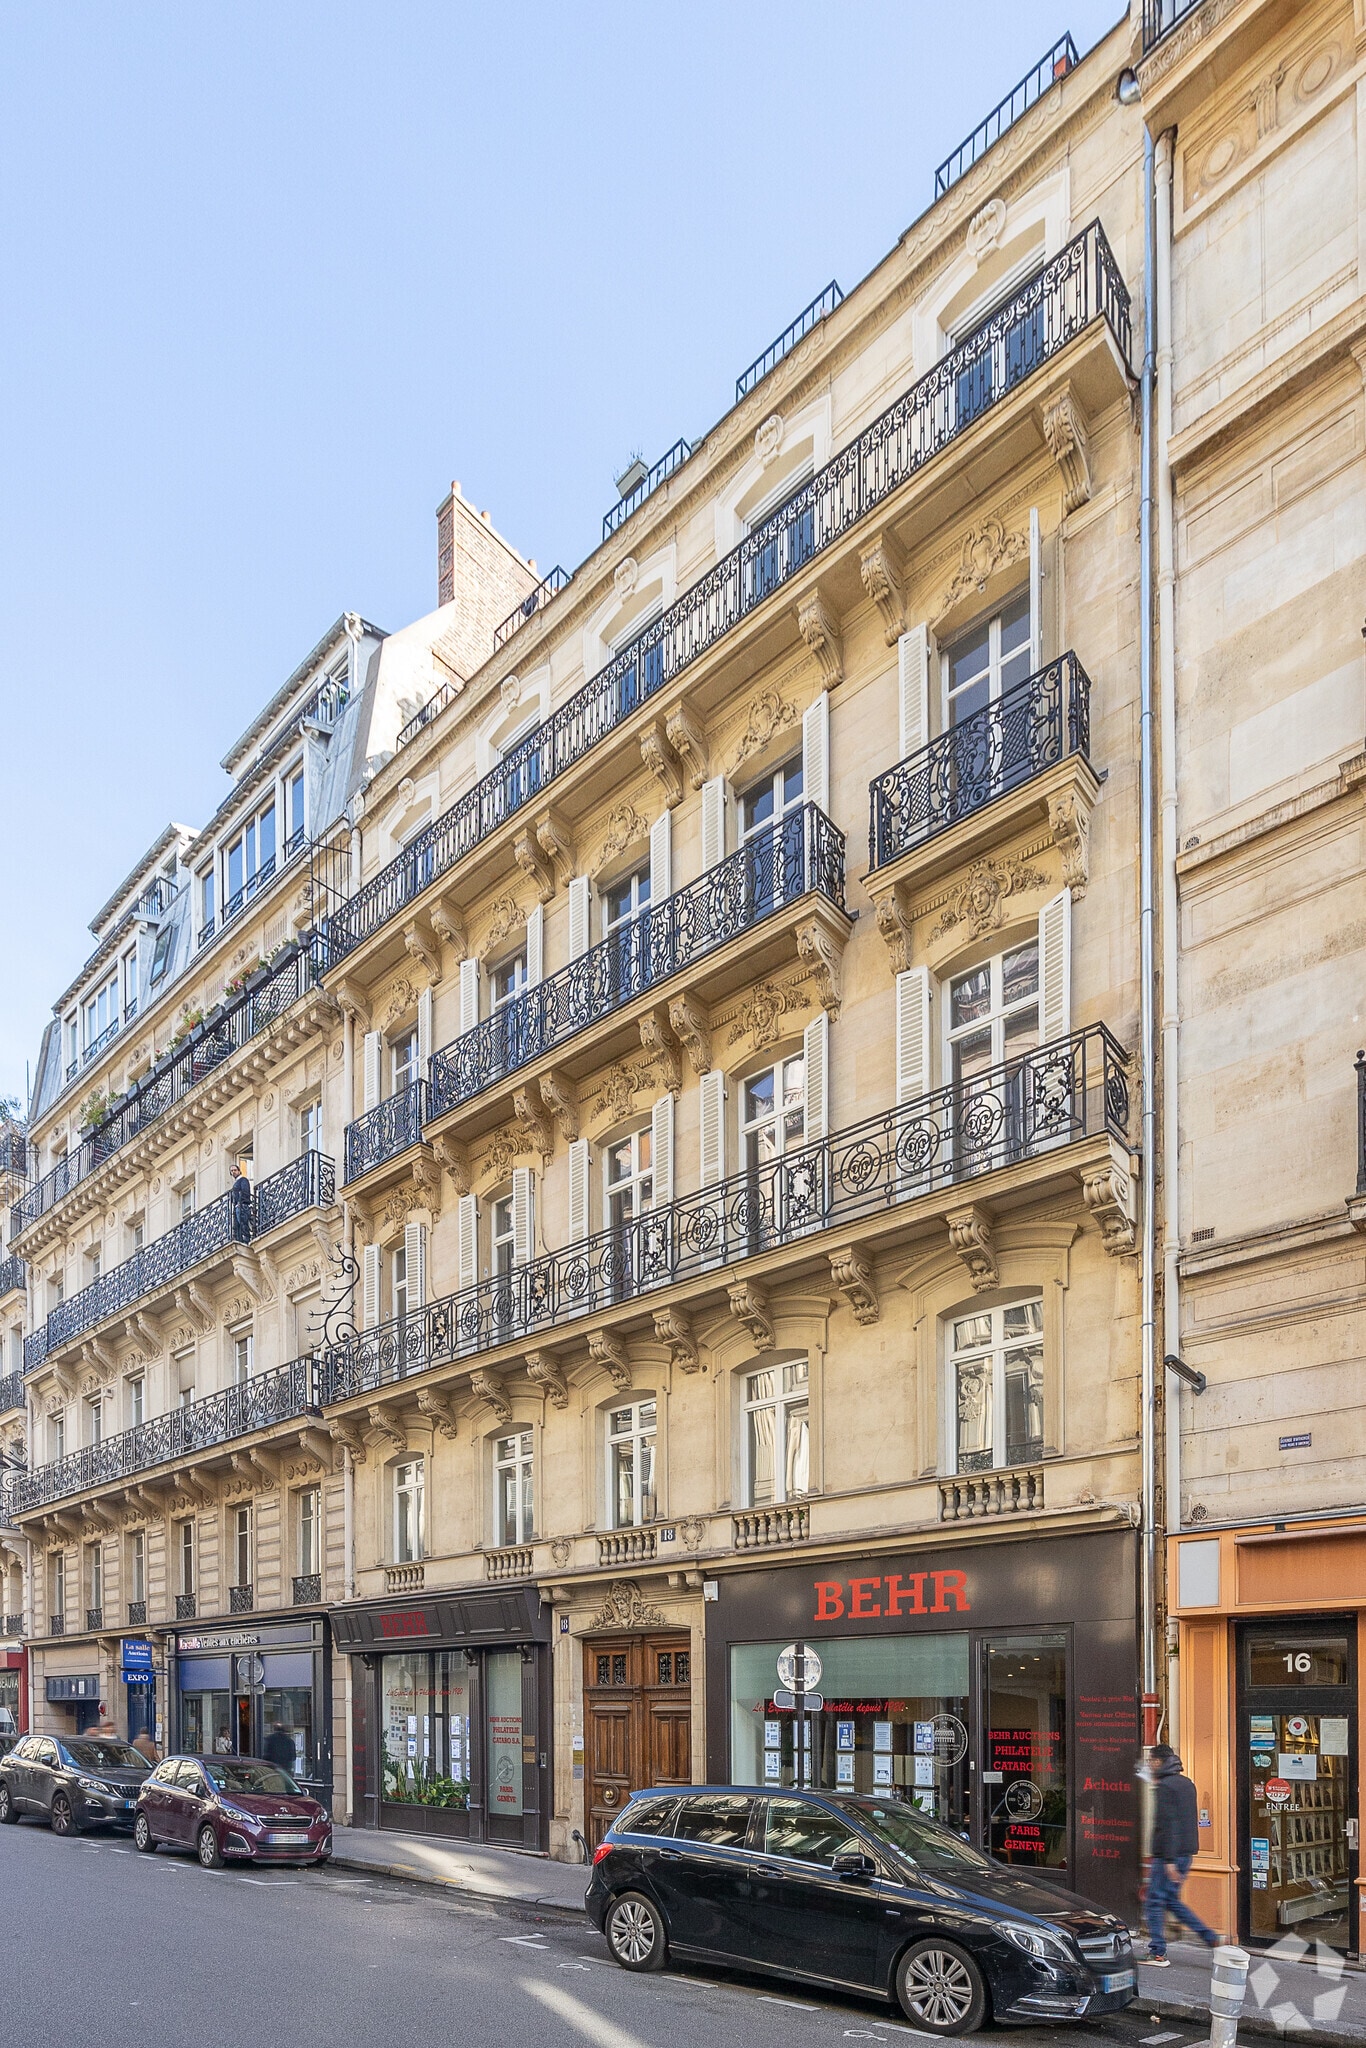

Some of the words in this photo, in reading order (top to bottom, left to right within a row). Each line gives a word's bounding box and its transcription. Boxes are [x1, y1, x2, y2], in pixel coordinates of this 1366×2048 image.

[664, 1529, 673, 1541] 18
[813, 1569, 971, 1621] BEHR
[379, 1611, 430, 1638] BEHR
[560, 1618, 568, 1630] 18
[1282, 1652, 1311, 1673] 16
[127, 1674, 149, 1682] EXPO
[856, 1701, 881, 1714] depuis
[492, 1726, 520, 1734] PHILATELIE
[988, 1731, 1011, 1741] BEHR
[1012, 1731, 1061, 1741] AUCTIONS
[994, 1745, 1054, 1756] PHILATELIE
[993, 1760, 1034, 1772] CATARO
[1036, 1762, 1056, 1773] S.A.
[1083, 1777, 1132, 1792] Achats
[1266, 1802, 1301, 1812] ENTREE
[1080, 1815, 1134, 1827] Estimations
[1010, 1825, 1041, 1837] PARIS
[1084, 1830, 1130, 1842] Expertises
[1004, 1840, 1046, 1852] GENEVE
